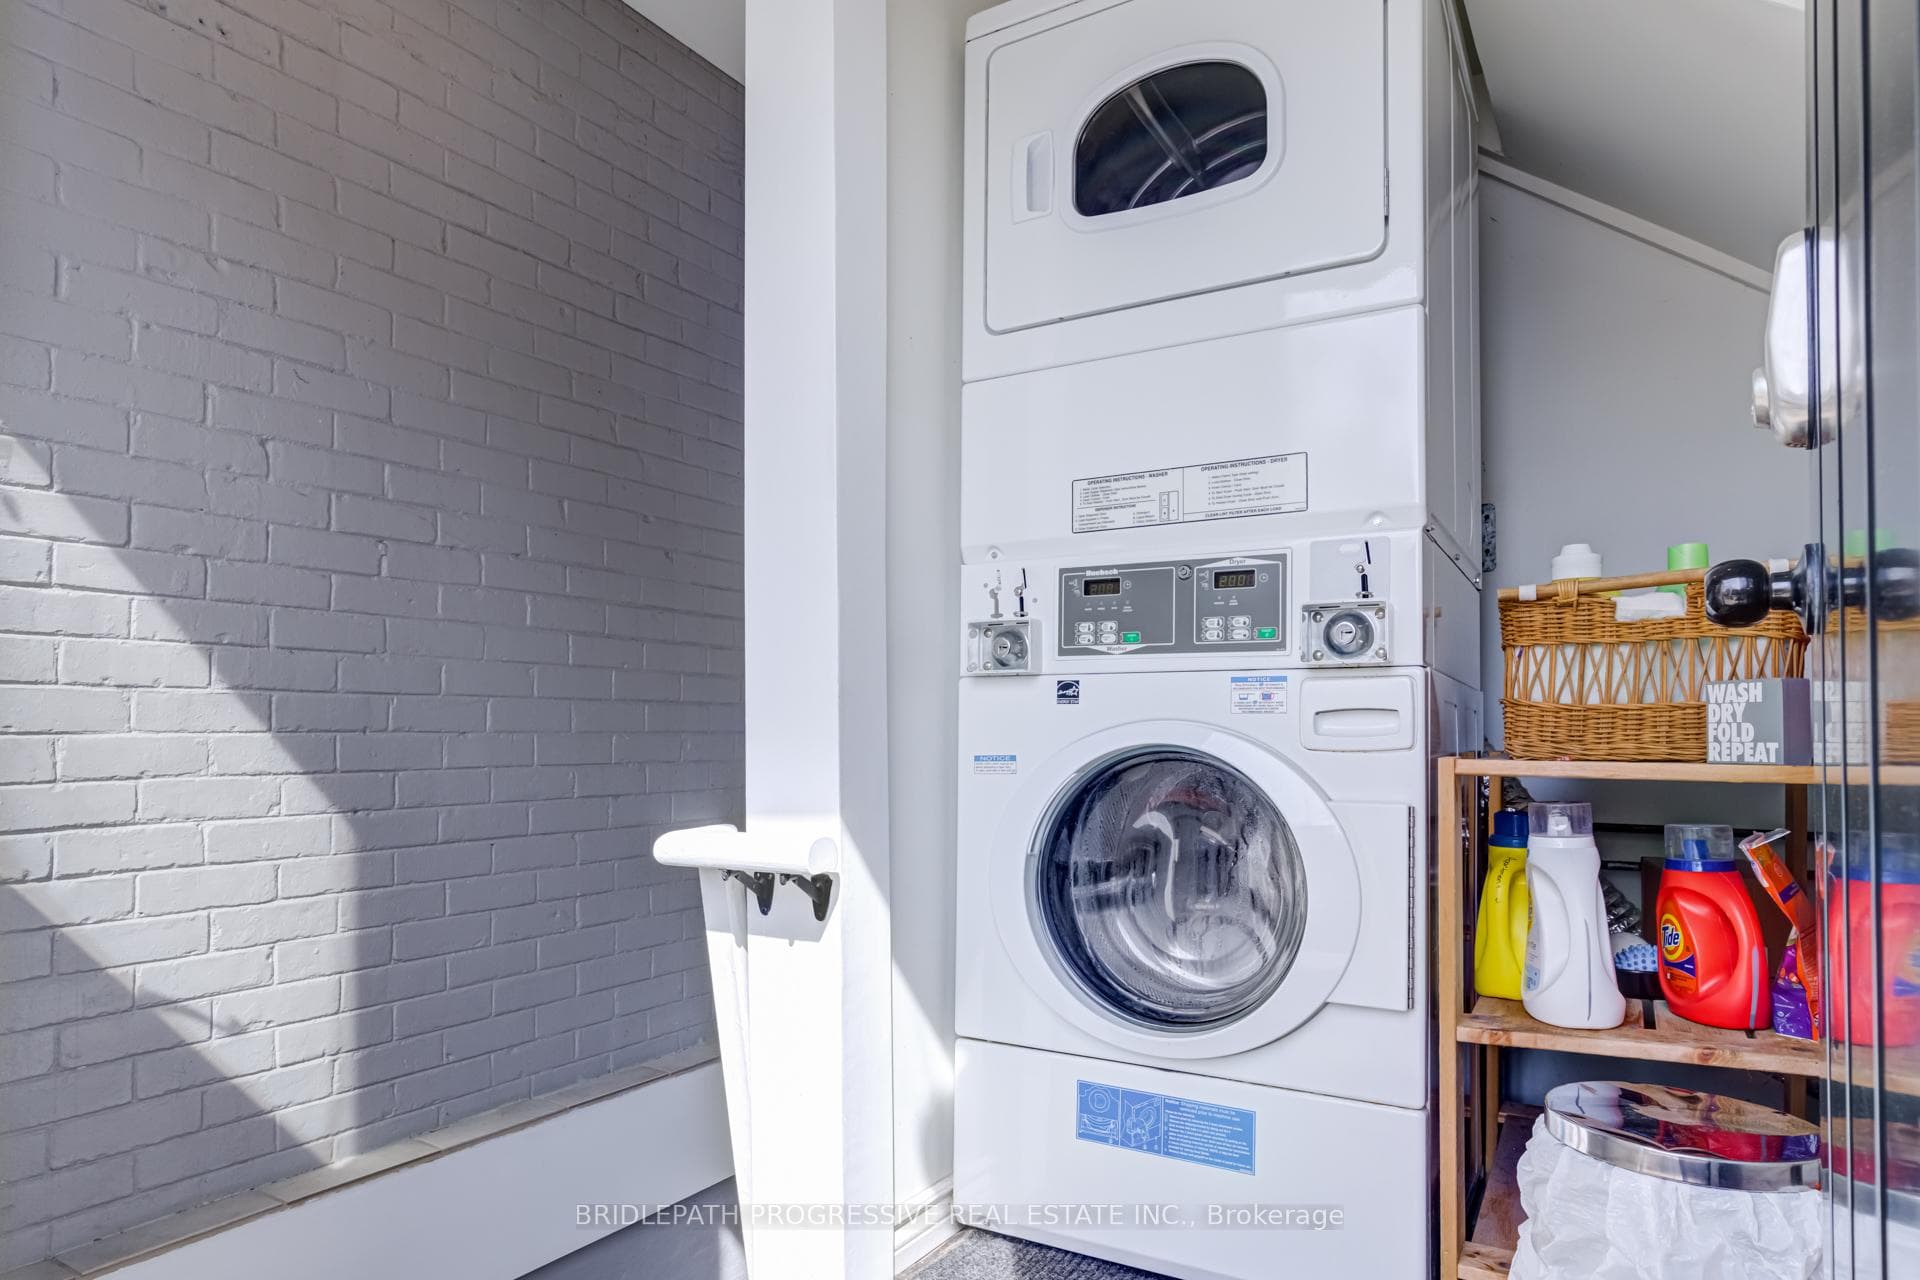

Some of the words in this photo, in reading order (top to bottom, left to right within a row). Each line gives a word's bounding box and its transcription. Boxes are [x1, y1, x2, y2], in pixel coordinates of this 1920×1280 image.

[1201, 464, 1229, 472] OPERATING
[1230, 460, 1267, 468] INSTRUCTIONS
[1087, 478, 1112, 486] OPERATING
[1112, 474, 1145, 483] INSTRUCTIONS
[1707, 682, 1762, 703] WASH
[1708, 702, 1746, 723] DRY
[1708, 722, 1755, 743] FOLD
[1708, 742, 1779, 763] REPEAT
[1661, 925, 1680, 948] Tide
